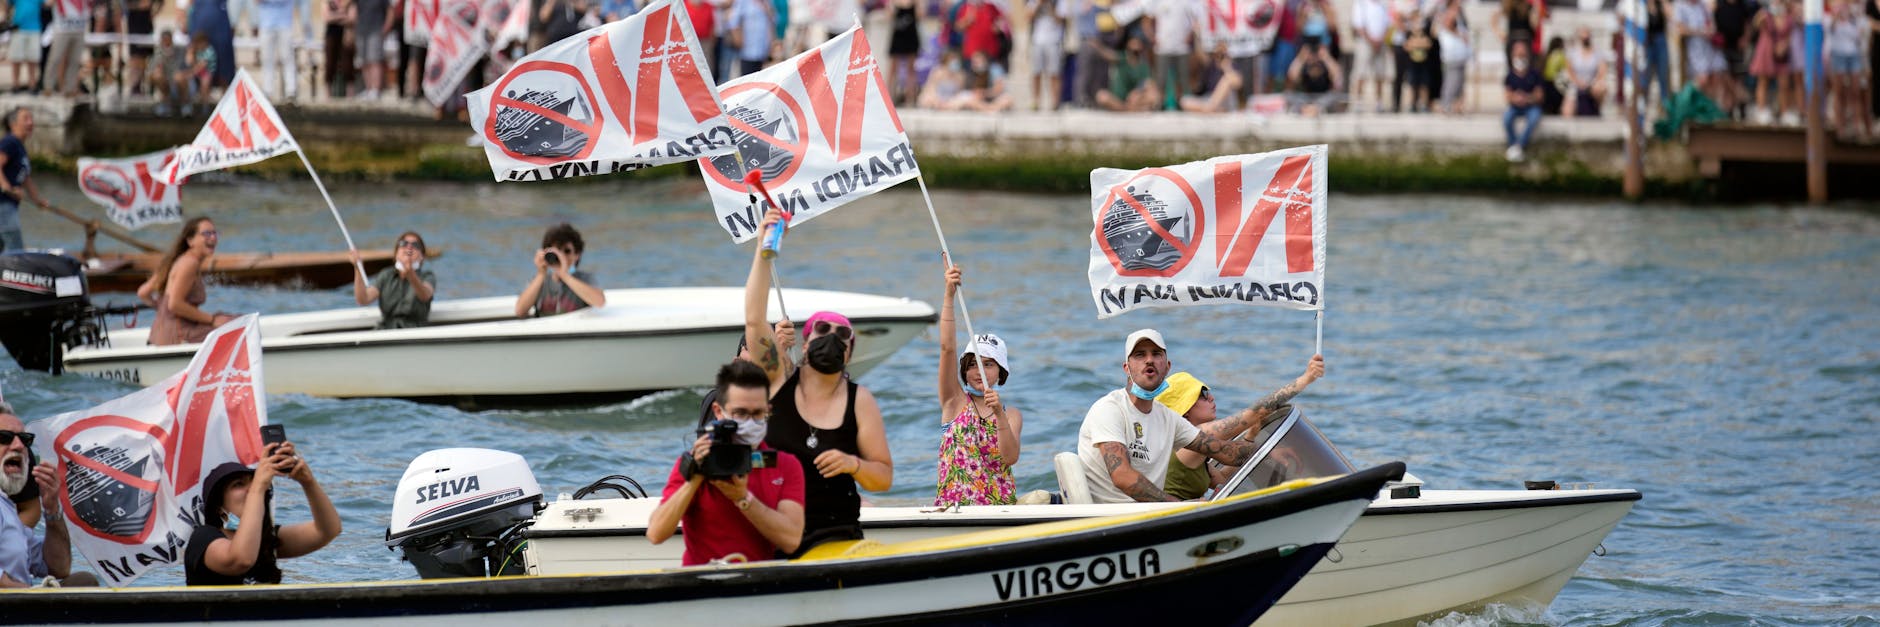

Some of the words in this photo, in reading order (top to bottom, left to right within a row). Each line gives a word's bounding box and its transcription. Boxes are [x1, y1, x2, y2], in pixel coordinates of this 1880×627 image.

[2, 269, 55, 289] SUZUKI
[416, 475, 480, 505] SELVA
[992, 548, 1161, 601] VIRGOLA
